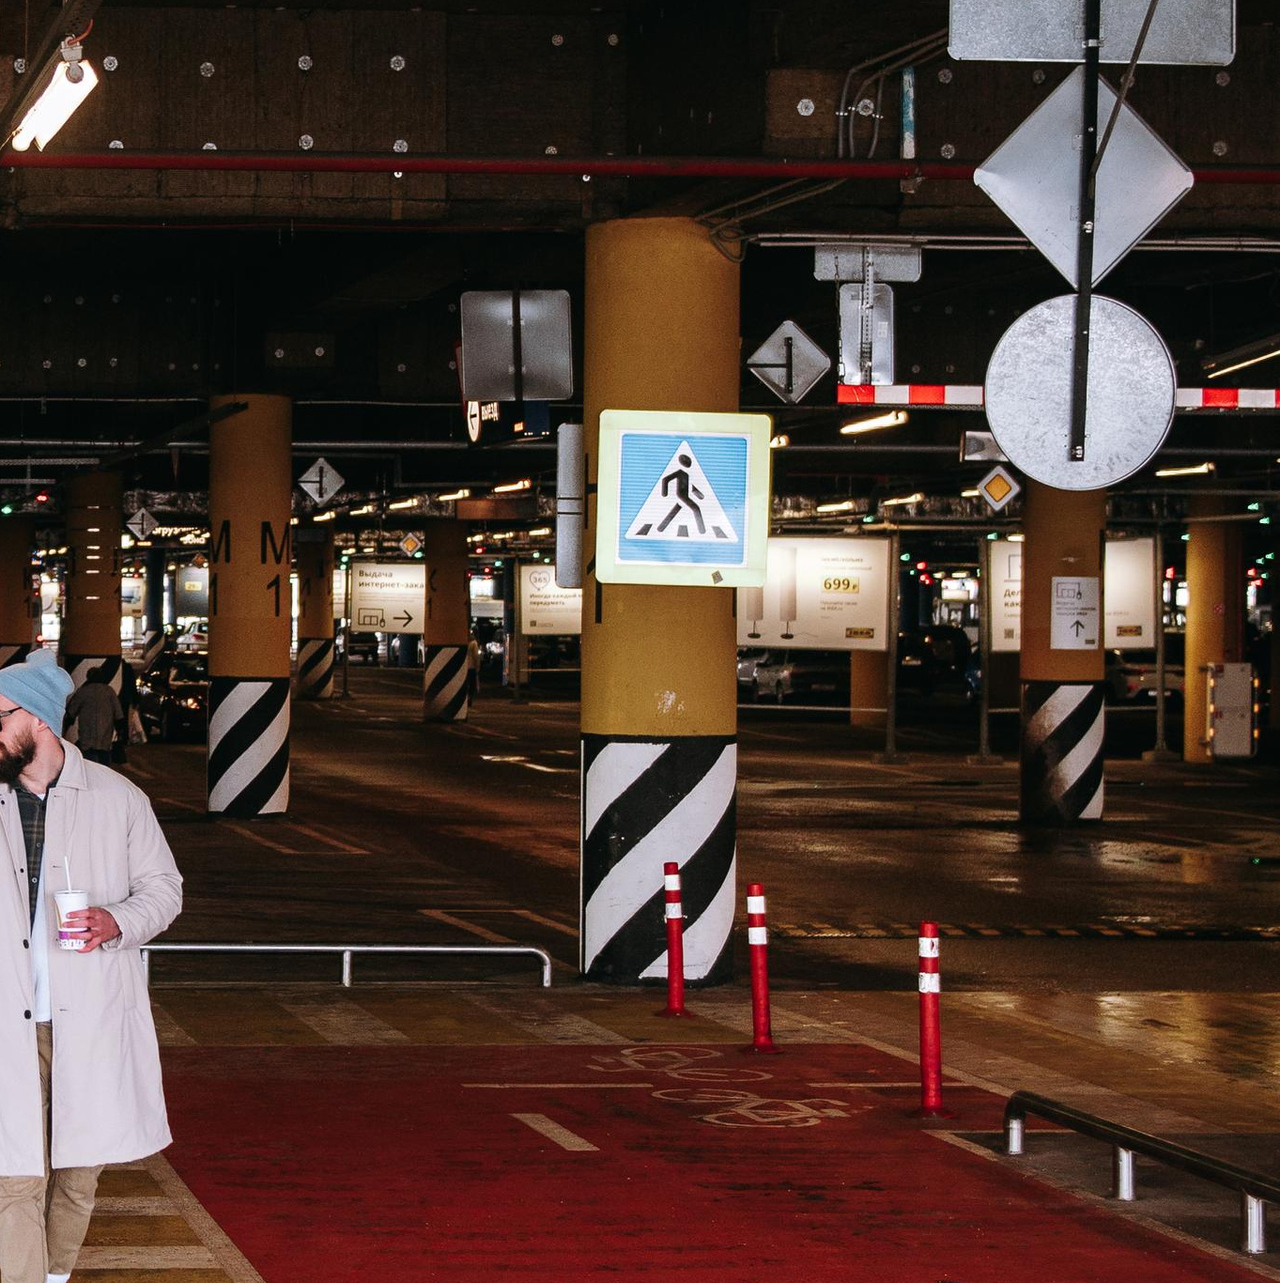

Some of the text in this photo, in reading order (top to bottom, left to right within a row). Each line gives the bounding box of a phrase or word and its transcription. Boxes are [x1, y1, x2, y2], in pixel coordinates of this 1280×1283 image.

[358, 570, 393, 579] Выдача
[823, 577, 851, 591] 699
[267, 574, 280, 617] 1
